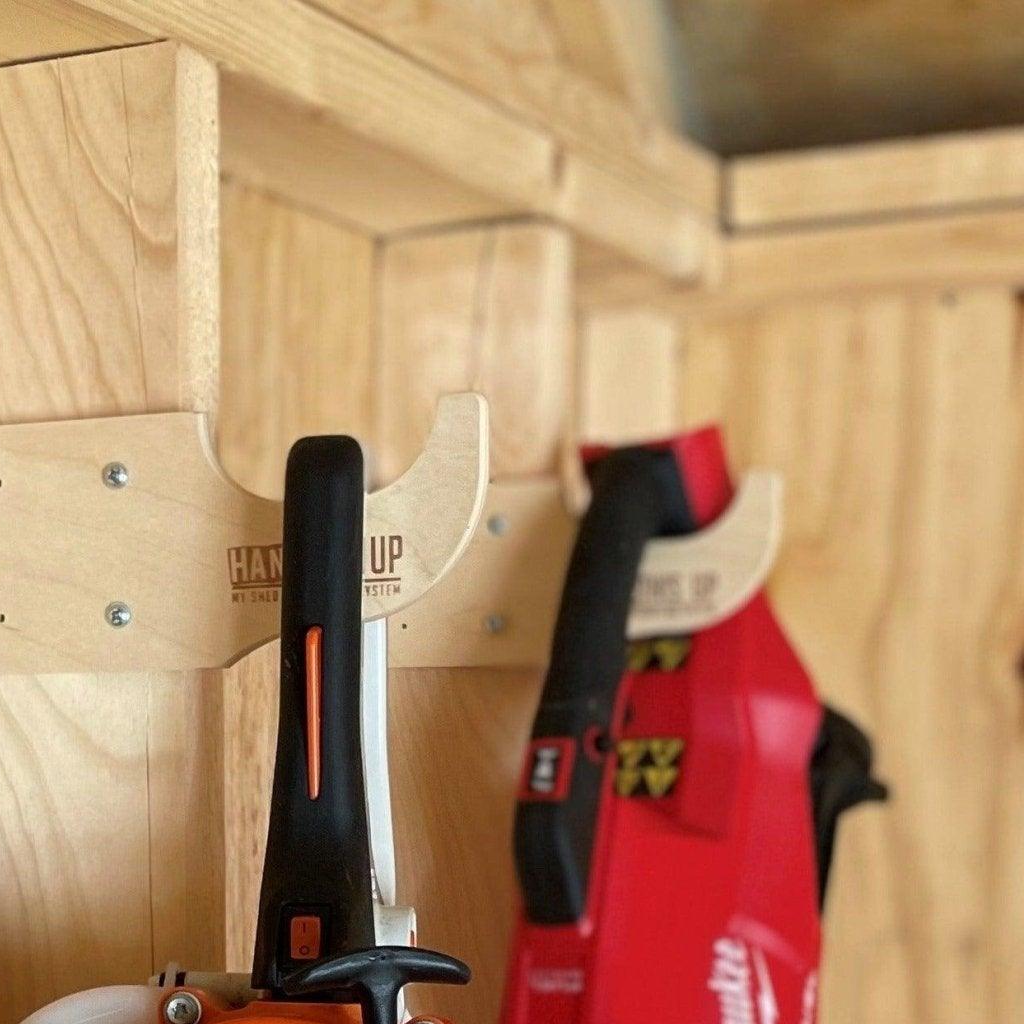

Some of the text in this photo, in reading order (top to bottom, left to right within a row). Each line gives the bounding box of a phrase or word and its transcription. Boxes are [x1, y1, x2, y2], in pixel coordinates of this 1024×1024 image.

[232, 535, 403, 583] HAN UP
[363, 583, 401, 597] YSTEM
